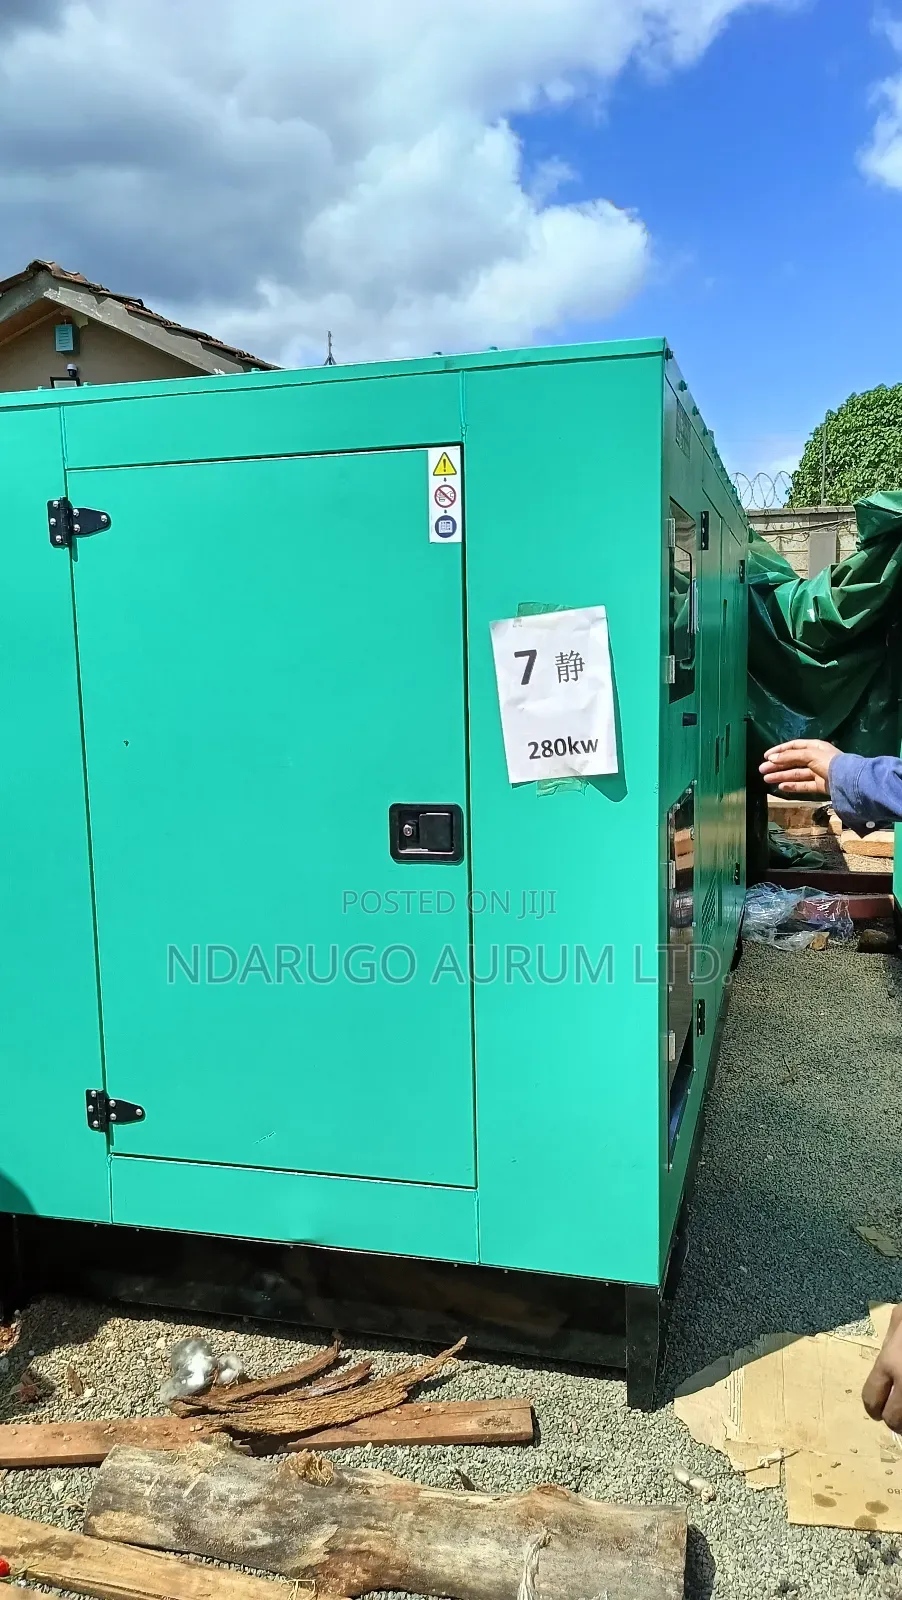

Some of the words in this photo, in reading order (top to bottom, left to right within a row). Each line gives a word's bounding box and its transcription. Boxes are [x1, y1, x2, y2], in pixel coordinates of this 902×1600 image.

[514, 649, 537, 686] 7
[555, 650, 585, 683] 静
[527, 736, 599, 760] 280kw
